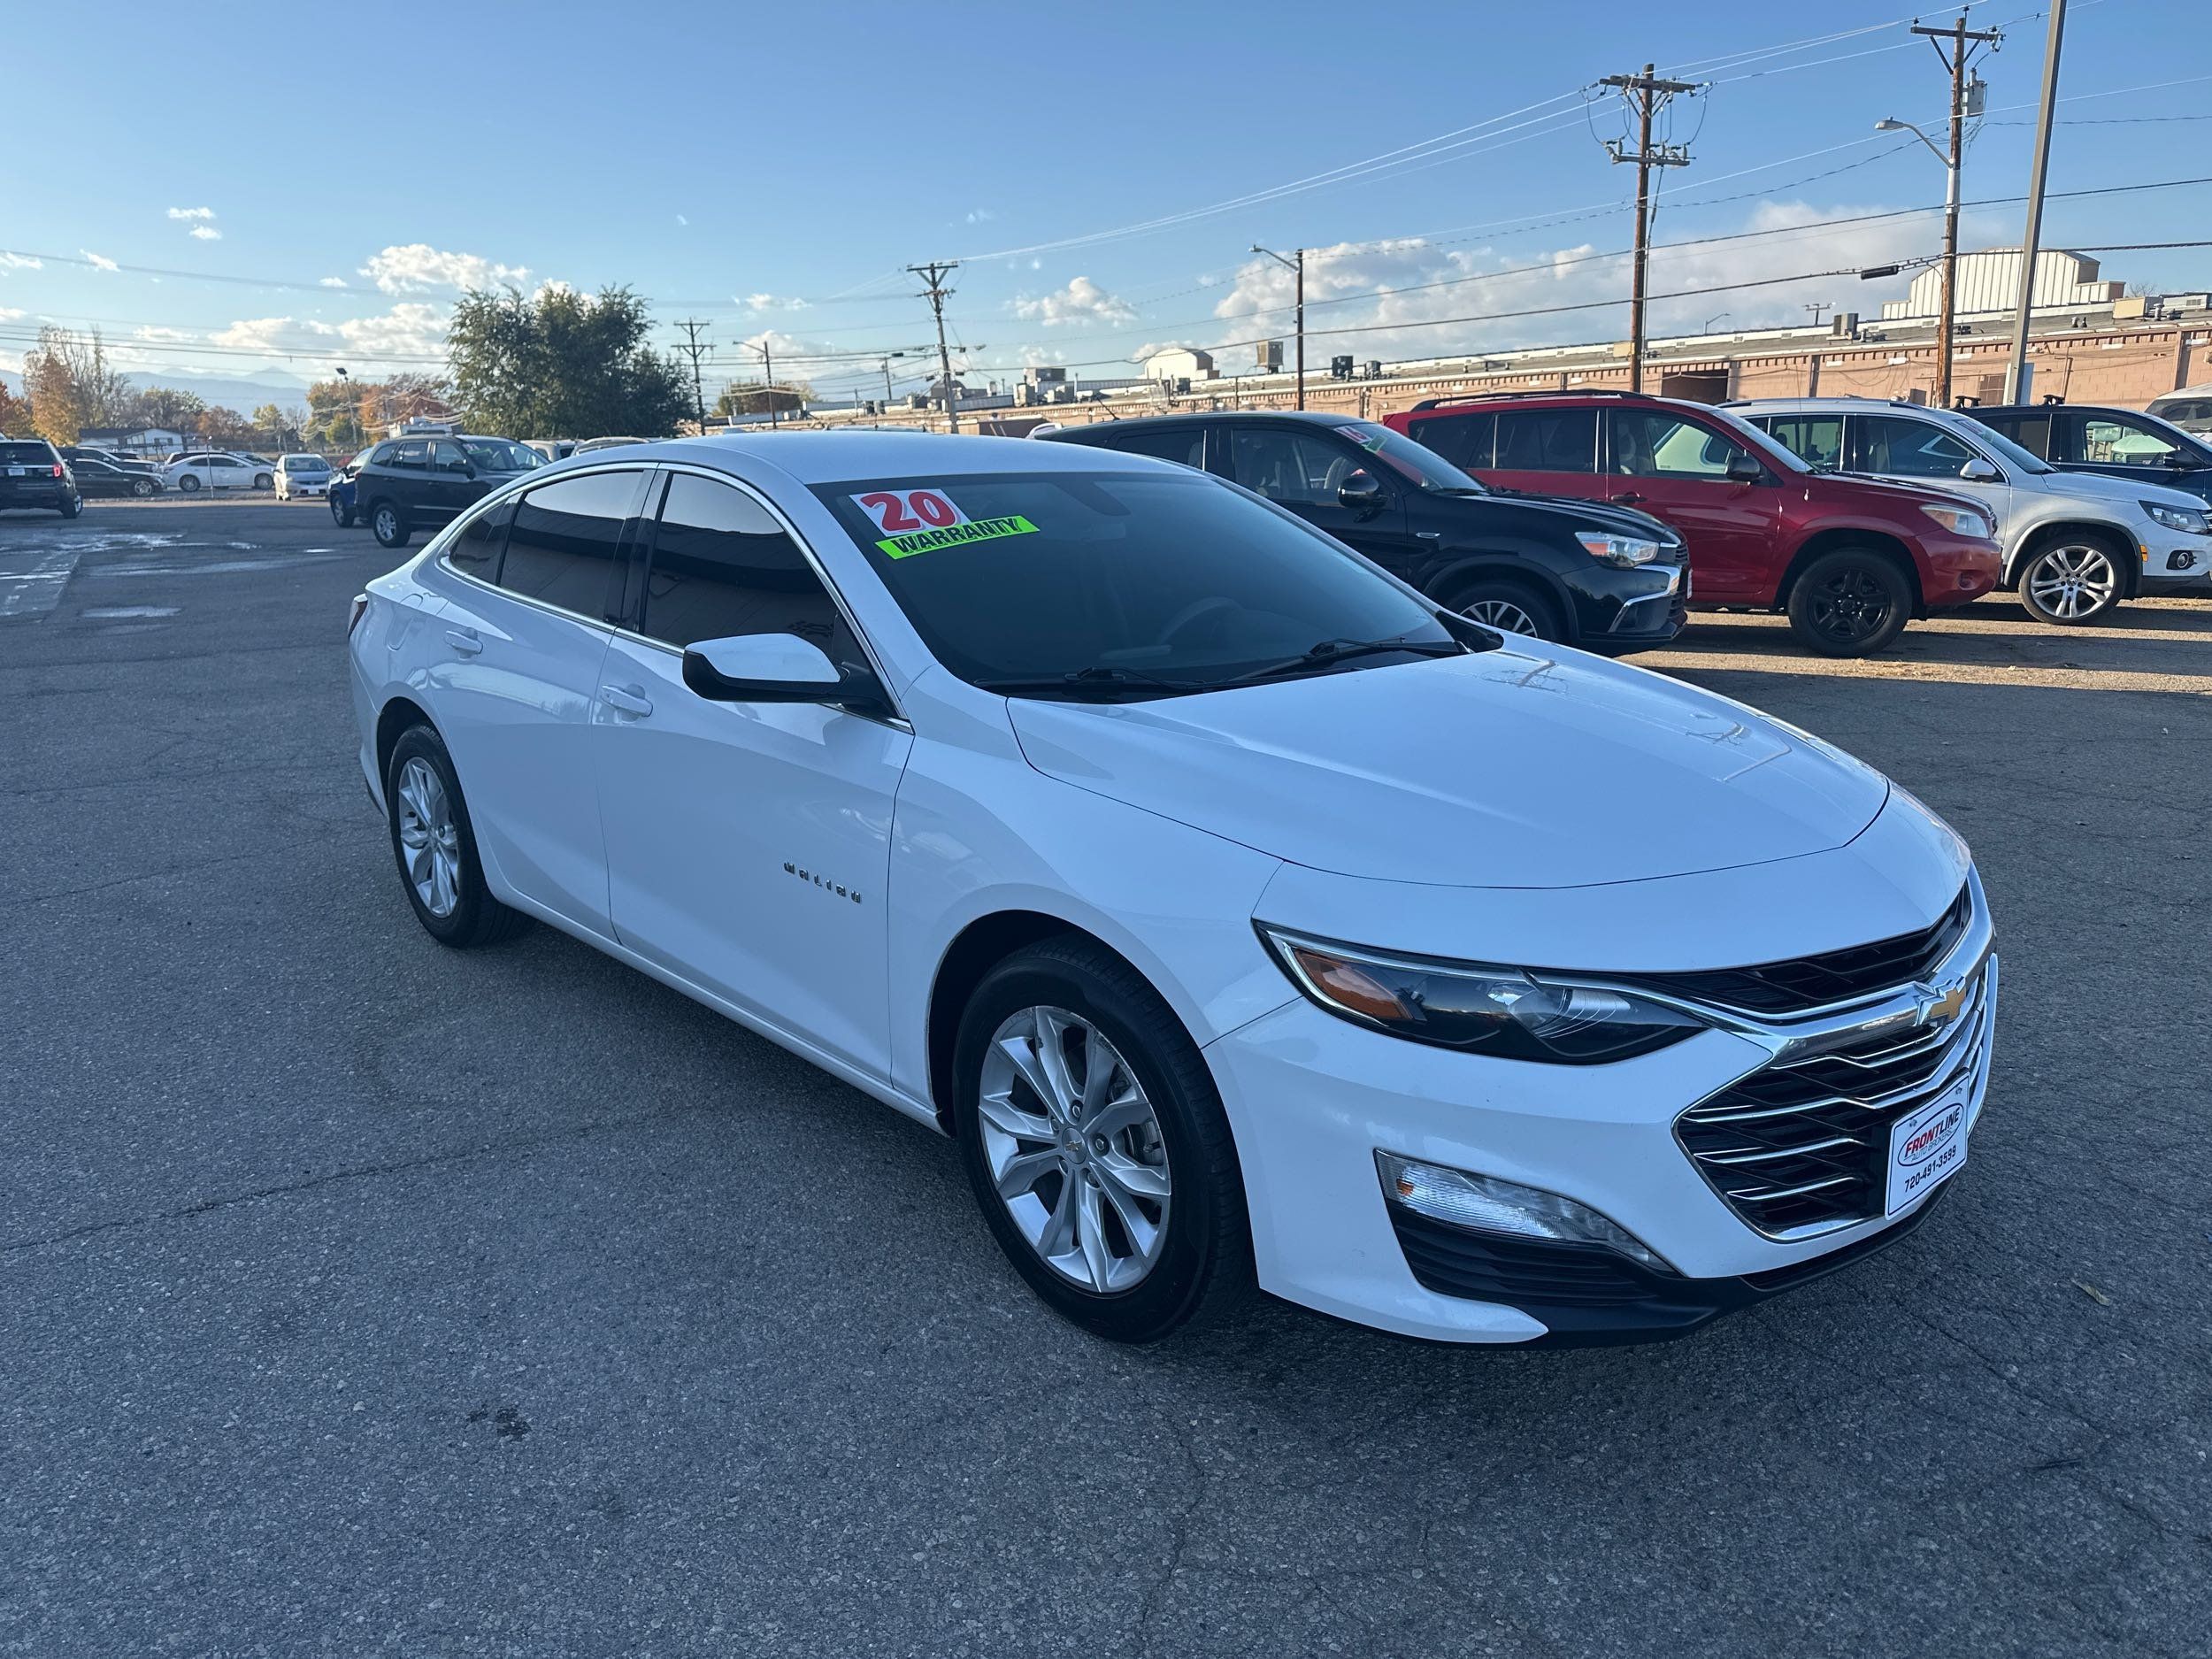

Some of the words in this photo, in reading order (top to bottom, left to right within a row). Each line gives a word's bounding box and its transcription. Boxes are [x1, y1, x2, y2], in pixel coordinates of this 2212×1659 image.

[860, 491, 958, 532] 20
[891, 516, 1019, 554] WARRANTY
[1904, 1107, 1961, 1158] FRONTLINE
[1905, 1145, 1956, 1193] 720-491-3599
